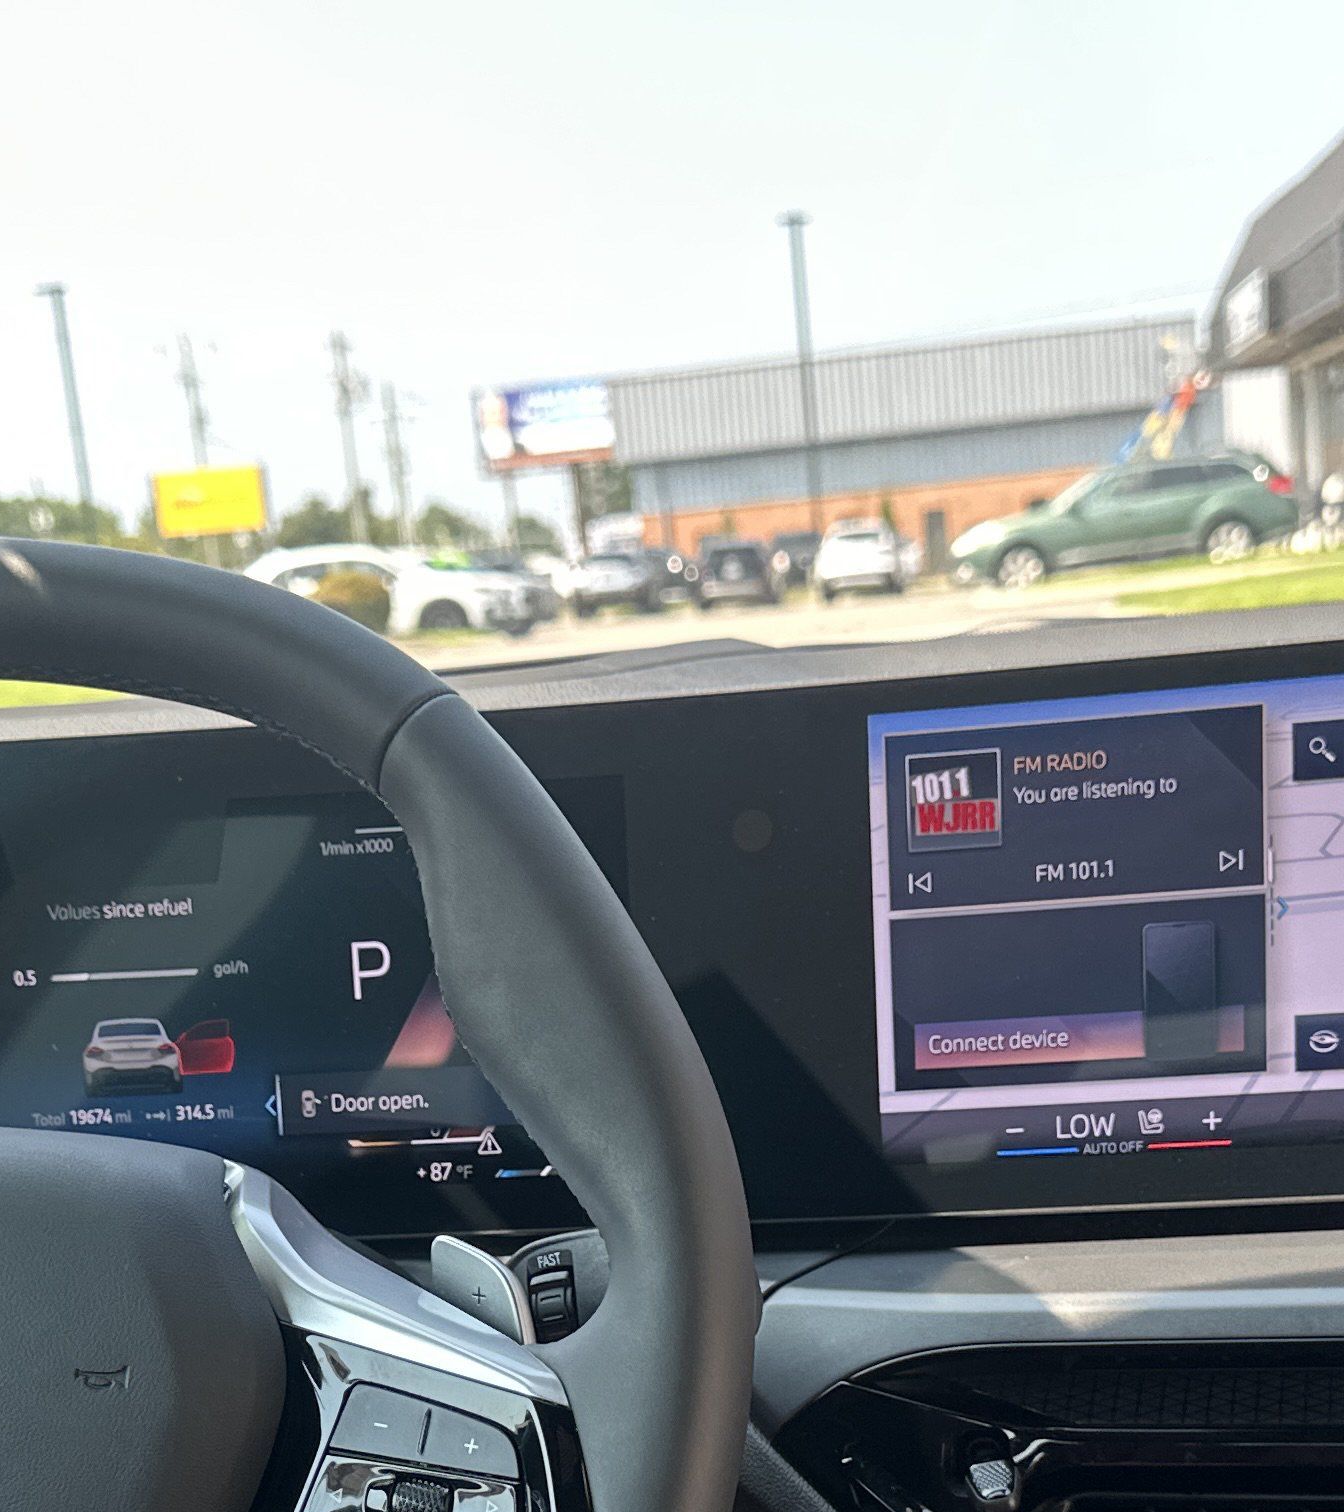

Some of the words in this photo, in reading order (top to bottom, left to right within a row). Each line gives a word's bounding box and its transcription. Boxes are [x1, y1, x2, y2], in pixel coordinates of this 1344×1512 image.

[1013, 755, 1042, 776] FM
[1047, 750, 1108, 772] RADIO
[1013, 786, 1047, 805] You
[1050, 786, 1079, 802] are
[1082, 777, 1156, 800] listening
[1159, 776, 1178, 794] to
[917, 800, 996, 834] WJRR
[1035, 864, 1064, 883] FM
[1069, 859, 1115, 881] 101.1
[46, 903, 101, 921] Values
[102, 901, 145, 920] since
[148, 897, 193, 917] refuel
[13, 970, 37, 987] 0.5
[213, 960, 249, 978] gal/h
[350, 940, 392, 1000] P
[928, 1033, 1005, 1055] Connect
[1009, 1029, 1070, 1050] device
[175, 1105, 215, 1121] 314.5
[217, 1106, 234, 1119] mi
[331, 1093, 375, 1113] Door
[378, 1092, 429, 1113] open.
[31, 1112, 66, 1127] Total
[68, 1108, 113, 1125] 19674
[114, 1110, 132, 1123] mi
[1056, 1112, 1116, 1140] LOW
[1083, 1141, 1118, 1155] AUTO
[1119, 1140, 1144, 1154] OFF
[536, 1252, 561, 1268] FAST
